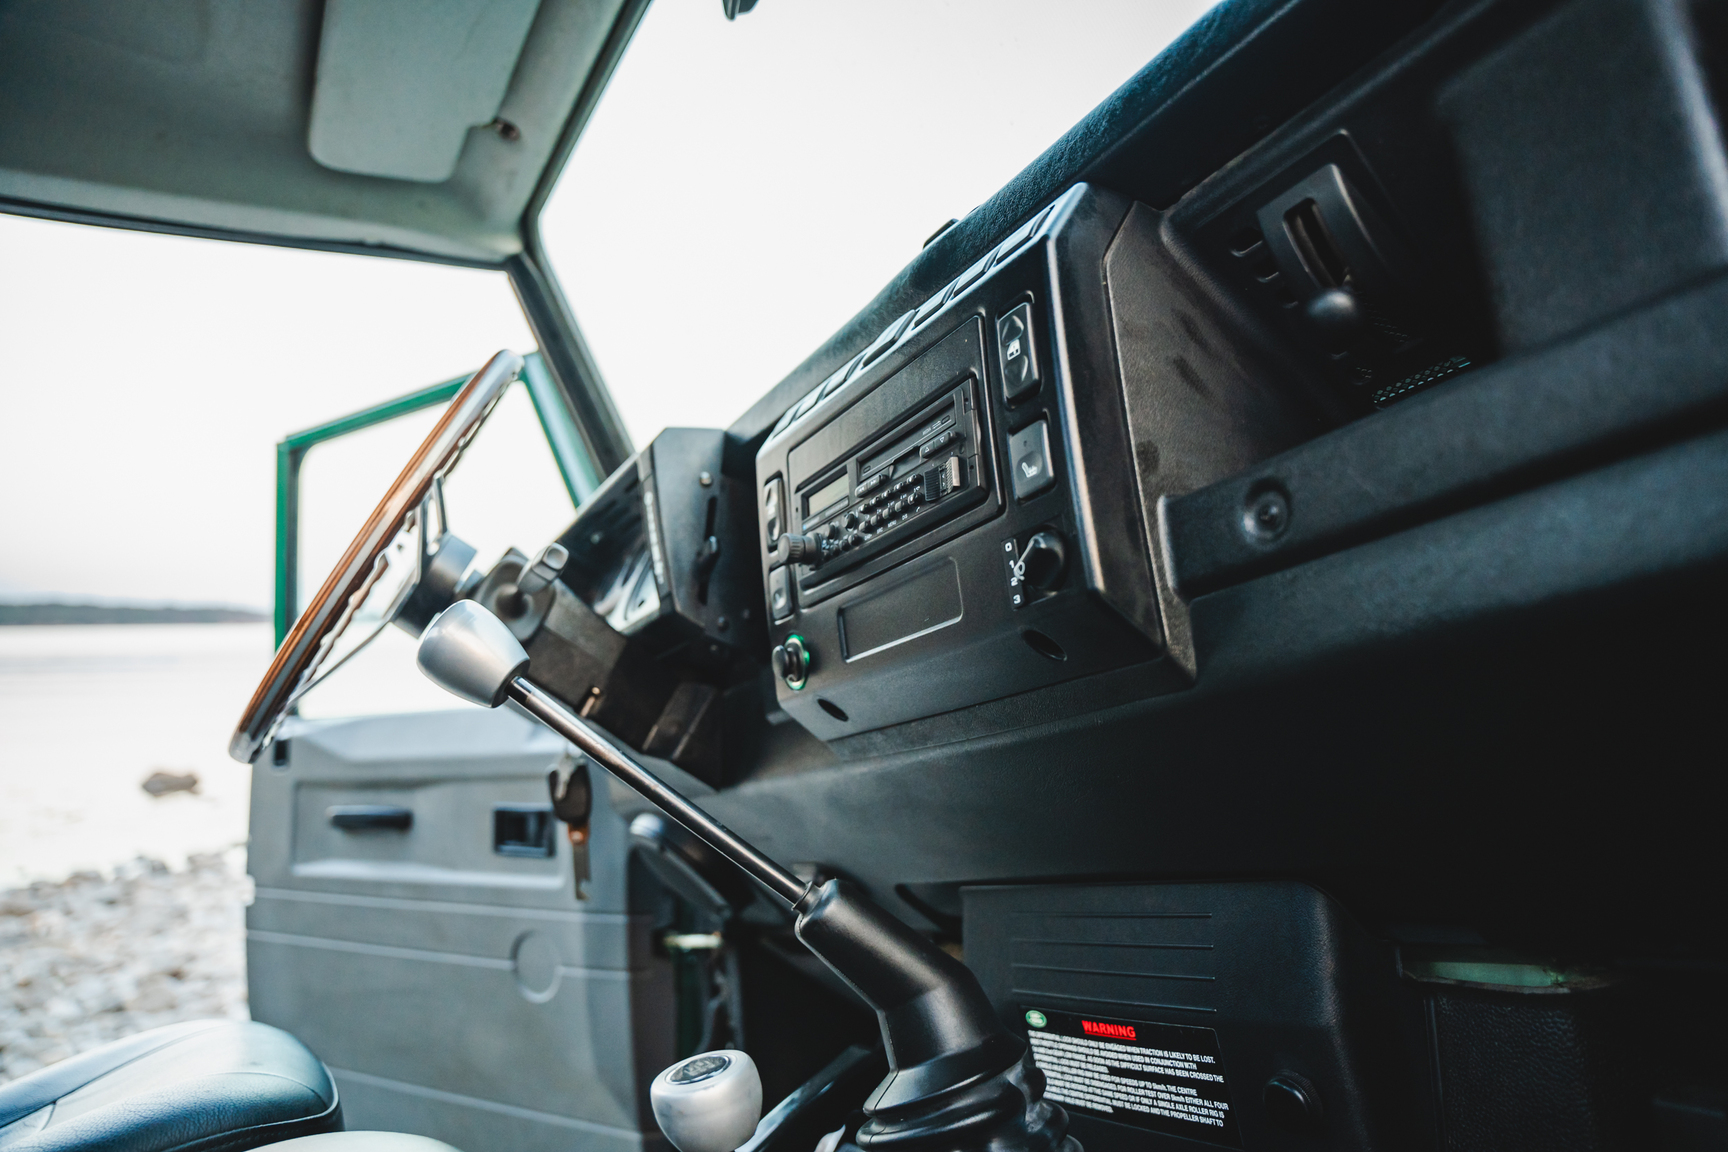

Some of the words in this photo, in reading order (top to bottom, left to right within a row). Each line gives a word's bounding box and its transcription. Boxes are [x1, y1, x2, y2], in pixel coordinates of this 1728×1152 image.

[1005, 542, 1012, 552] 0
[1013, 594, 1021, 604] 3
[1082, 1020, 1136, 1038] WARNING
[1140, 1048, 1163, 1057] TRACTION
[1169, 1051, 1185, 1059] LIKELY
[1201, 1056, 1215, 1064] LOST.
[1151, 1058, 1184, 1068] CONJUNCTION
[1120, 1061, 1142, 1071] DIFFICULT
[1143, 1065, 1164, 1074] SURFACE
[1176, 1069, 1189, 1077] BEEN
[1190, 1072, 1213, 1081] CROSSED
[1213, 1075, 1224, 1083] THE
[1127, 1087, 1145, 1095] ROLLER
[1157, 1092, 1170, 1100] OVER
[1185, 1097, 1203, 1105] EITHER
[1214, 1101, 1229, 1110] FOUR
[1177, 1087, 1197, 1096] CENTRE
[1176, 1103, 1188, 1111] AXLE
[1189, 1106, 1209, 1115] ROLLER
[1209, 1109, 1218, 1117] RIG
[1170, 1111, 1199, 1122] PROPELLER
[1199, 1116, 1216, 1125] SHAFT
